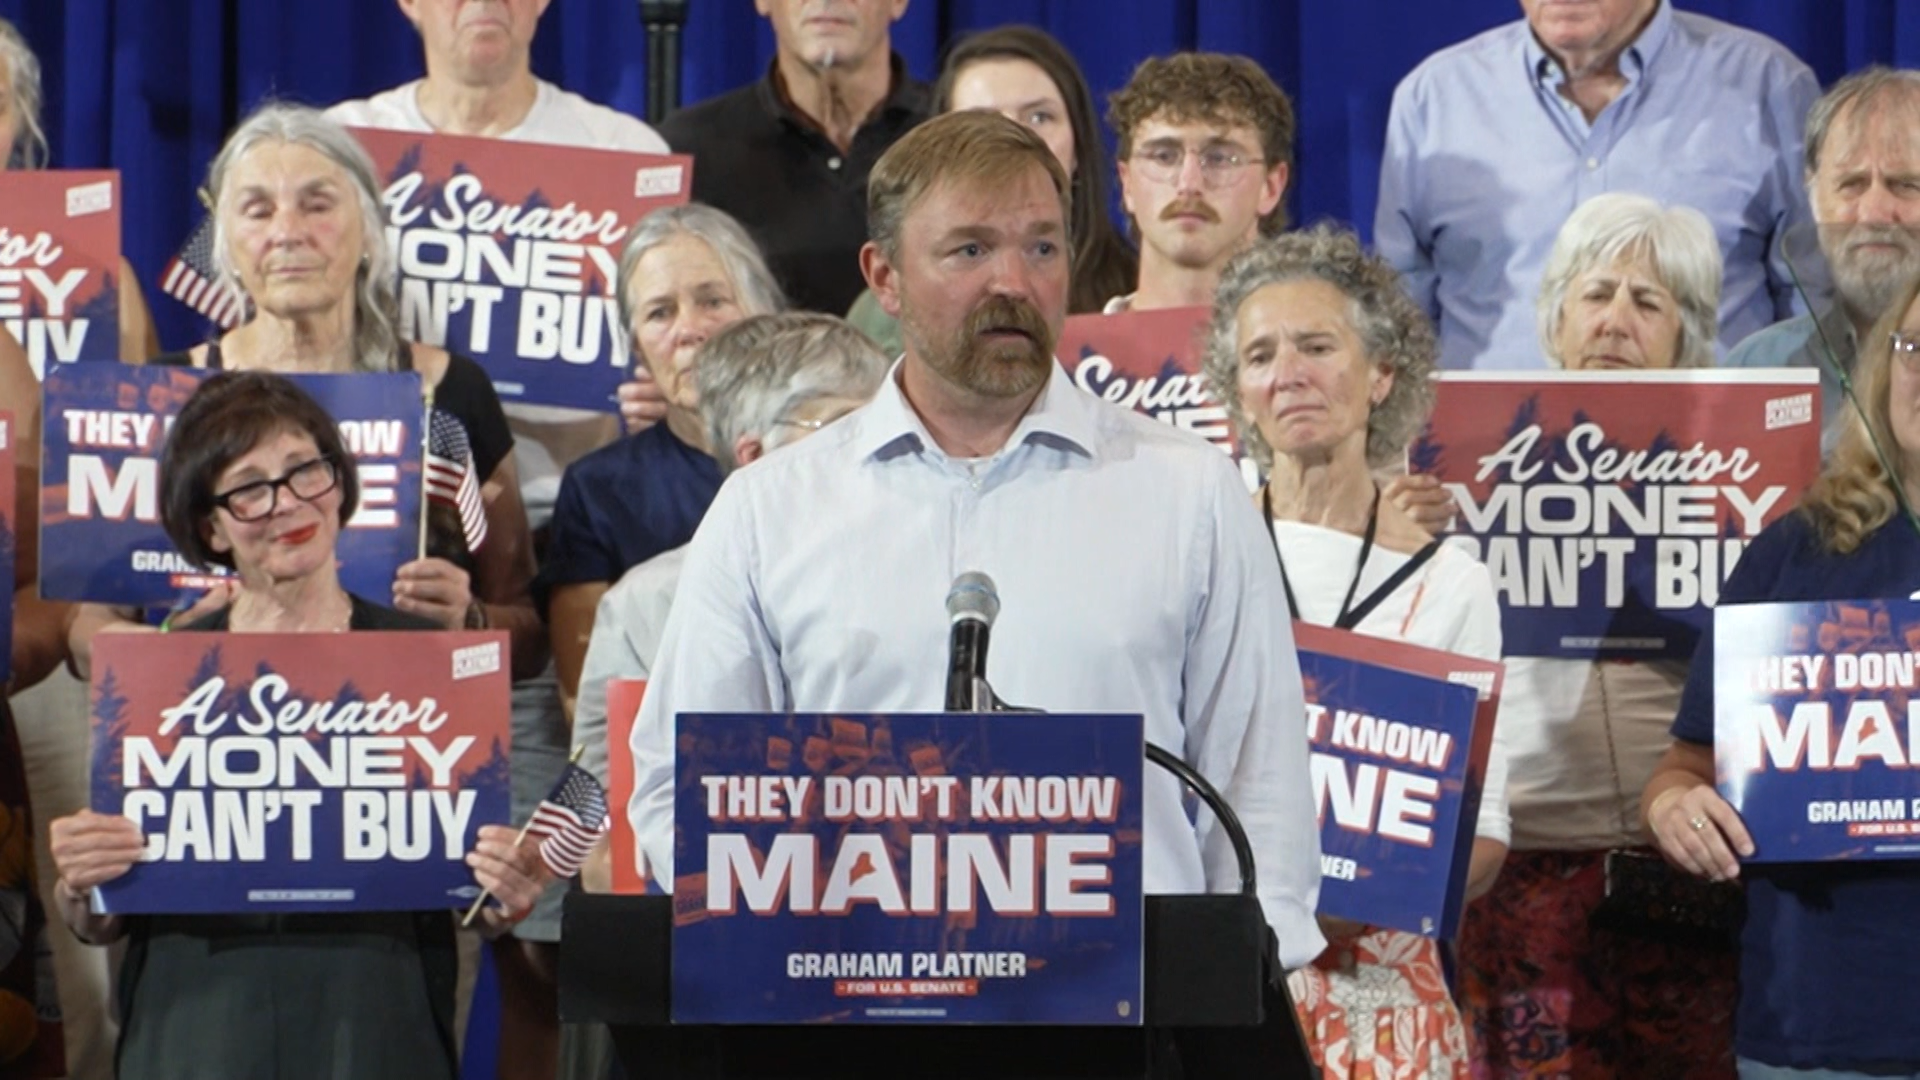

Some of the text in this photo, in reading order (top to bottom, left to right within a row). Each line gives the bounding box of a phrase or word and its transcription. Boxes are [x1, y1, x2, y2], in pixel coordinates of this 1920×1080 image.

[430, 173, 627, 244] Senator
[63, 409, 154, 448] THEY
[1476, 423, 1760, 482] A Senator
[1441, 483, 1786, 535] MONEY
[1446, 536, 1752, 609] AN'T BU
[1757, 654, 1825, 690] HEY
[158, 674, 448, 735] A Senator
[1332, 709, 1451, 768] KNOW
[1743, 700, 1920, 768] MAI
[122, 736, 476, 788] MONEY
[701, 776, 1117, 819] THEY DON'T KNOW
[1808, 799, 1905, 823] GRAHAM
[123, 790, 478, 862] CAN'T BUY
[707, 833, 1111, 913] MAINE
[787, 952, 1027, 978] GRAHAM PLATNER
[846, 982, 876, 994] FOR
[909, 982, 965, 994] SENATE
